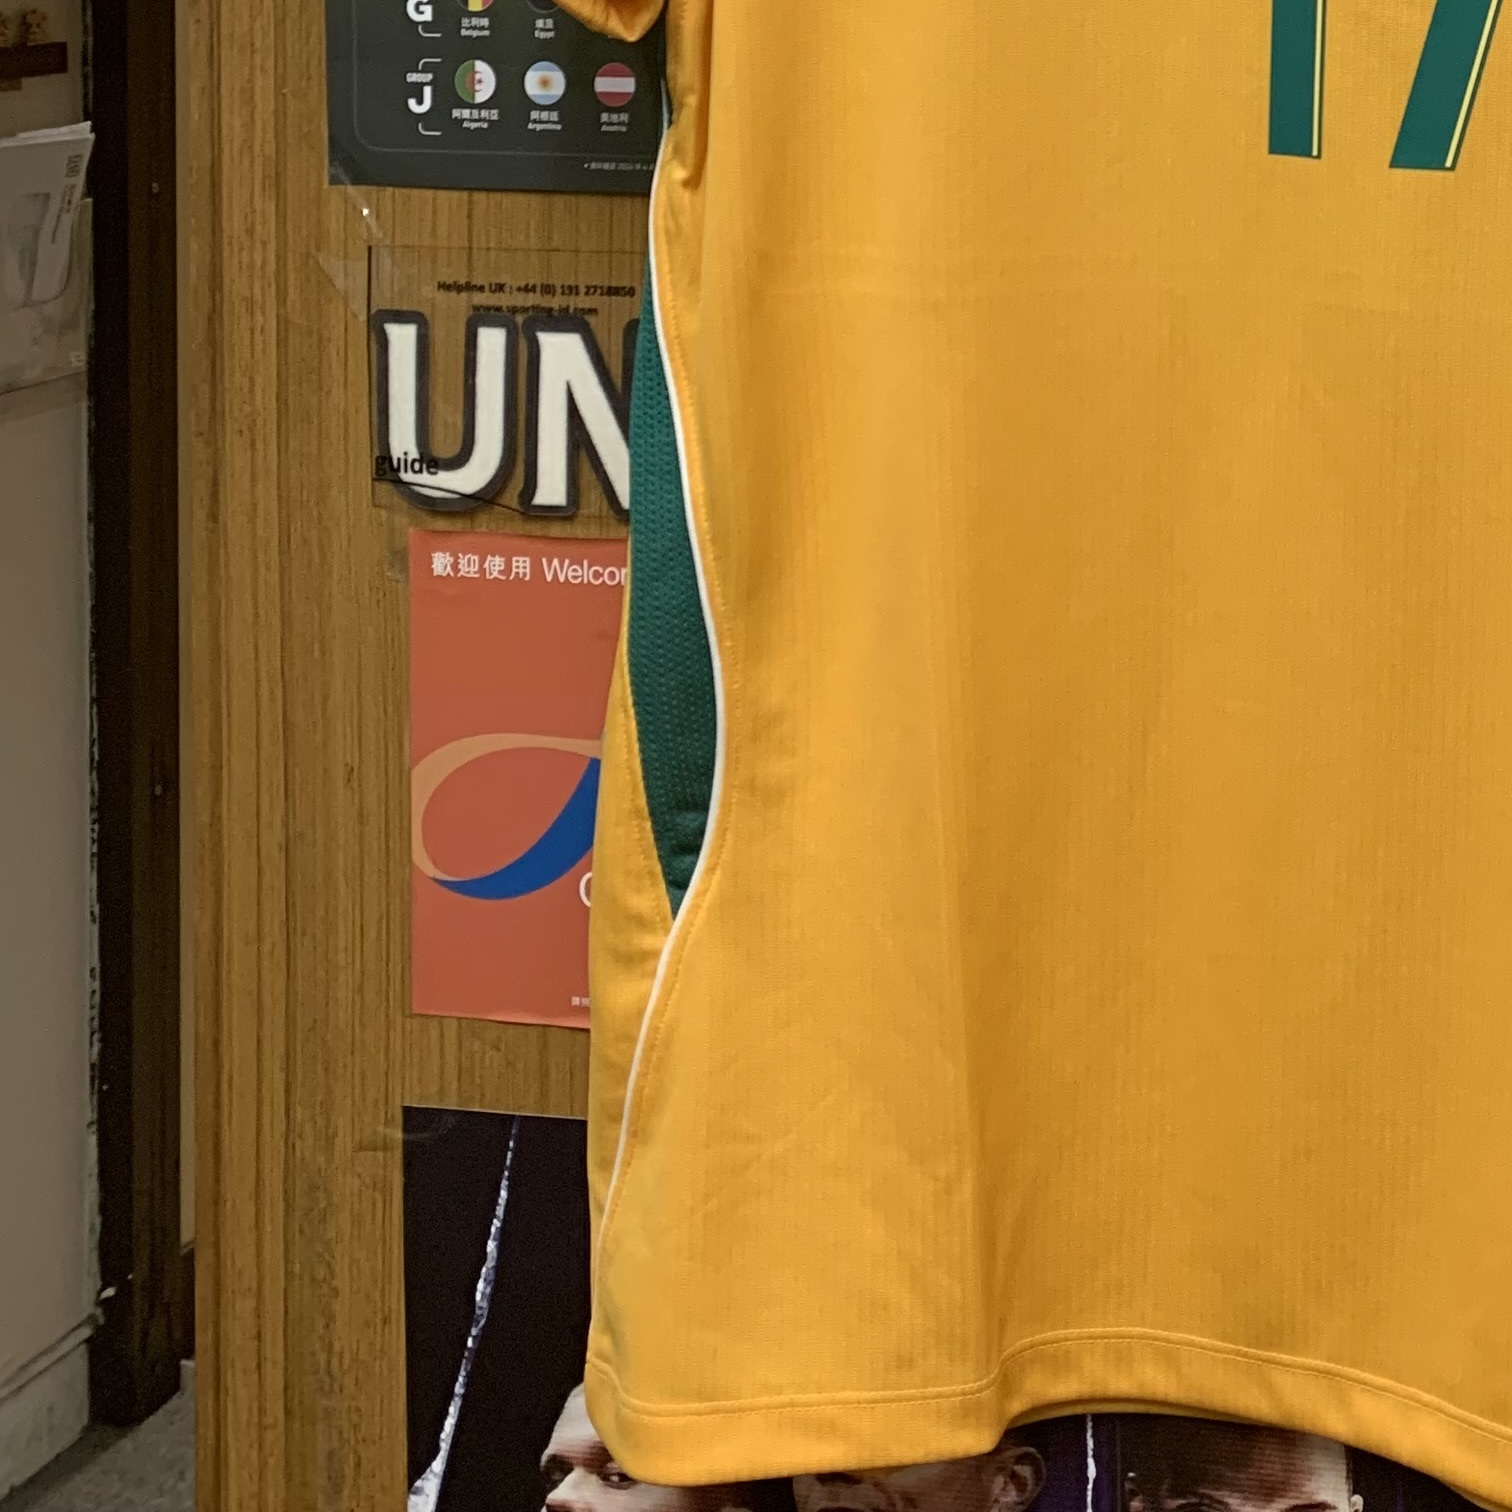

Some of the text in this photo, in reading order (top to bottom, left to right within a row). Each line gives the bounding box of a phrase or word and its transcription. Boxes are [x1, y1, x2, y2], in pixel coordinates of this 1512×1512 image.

[407, 85, 432, 114] J
[437, 281, 485, 295] Helpline
[489, 282, 506, 294] UK
[516, 284, 536, 295] +44
[375, 452, 439, 476] guide
[431, 552, 531, 581] 歡迎使用
